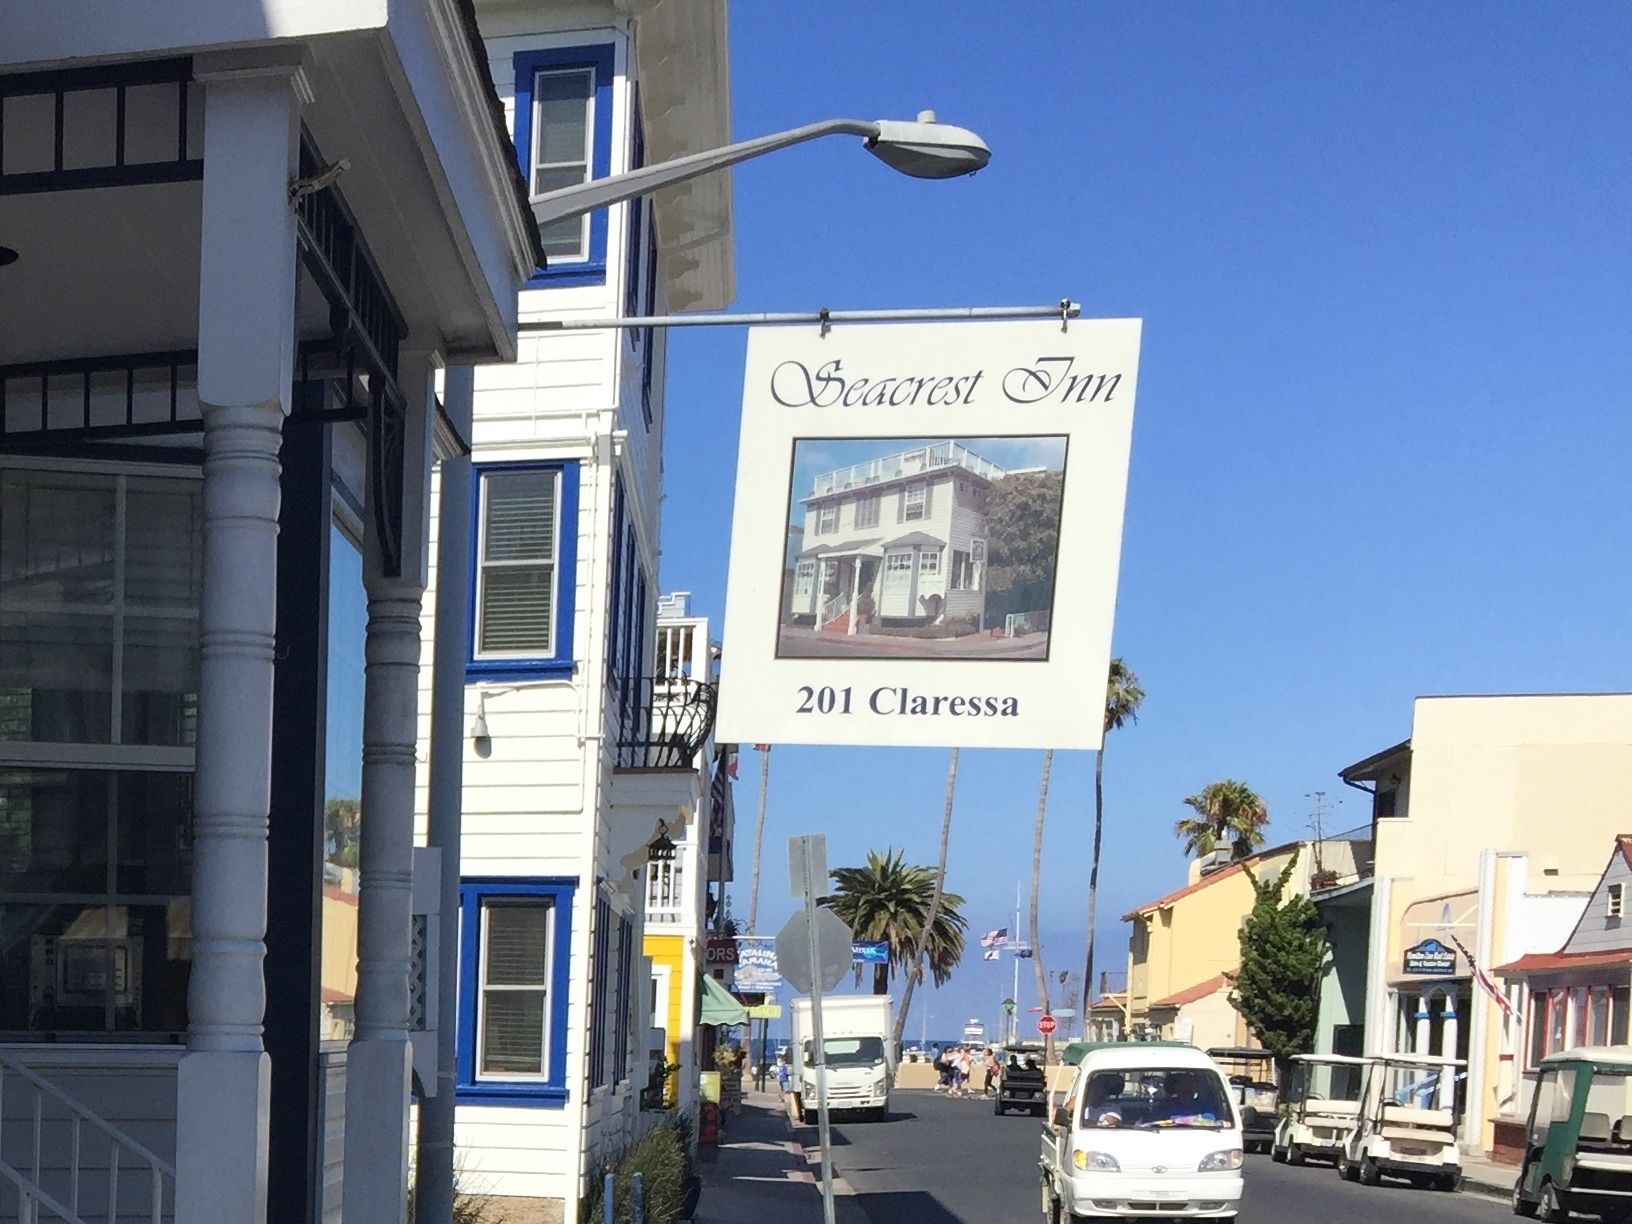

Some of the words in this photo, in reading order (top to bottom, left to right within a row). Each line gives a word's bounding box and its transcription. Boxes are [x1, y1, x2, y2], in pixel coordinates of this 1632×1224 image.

[770, 358, 984, 408] Seacrest
[1001, 356, 1122, 404] Inn
[796, 685, 854, 715] 201
[869, 686, 1020, 717] Claressa
[1039, 1020, 1055, 1029] STOP
